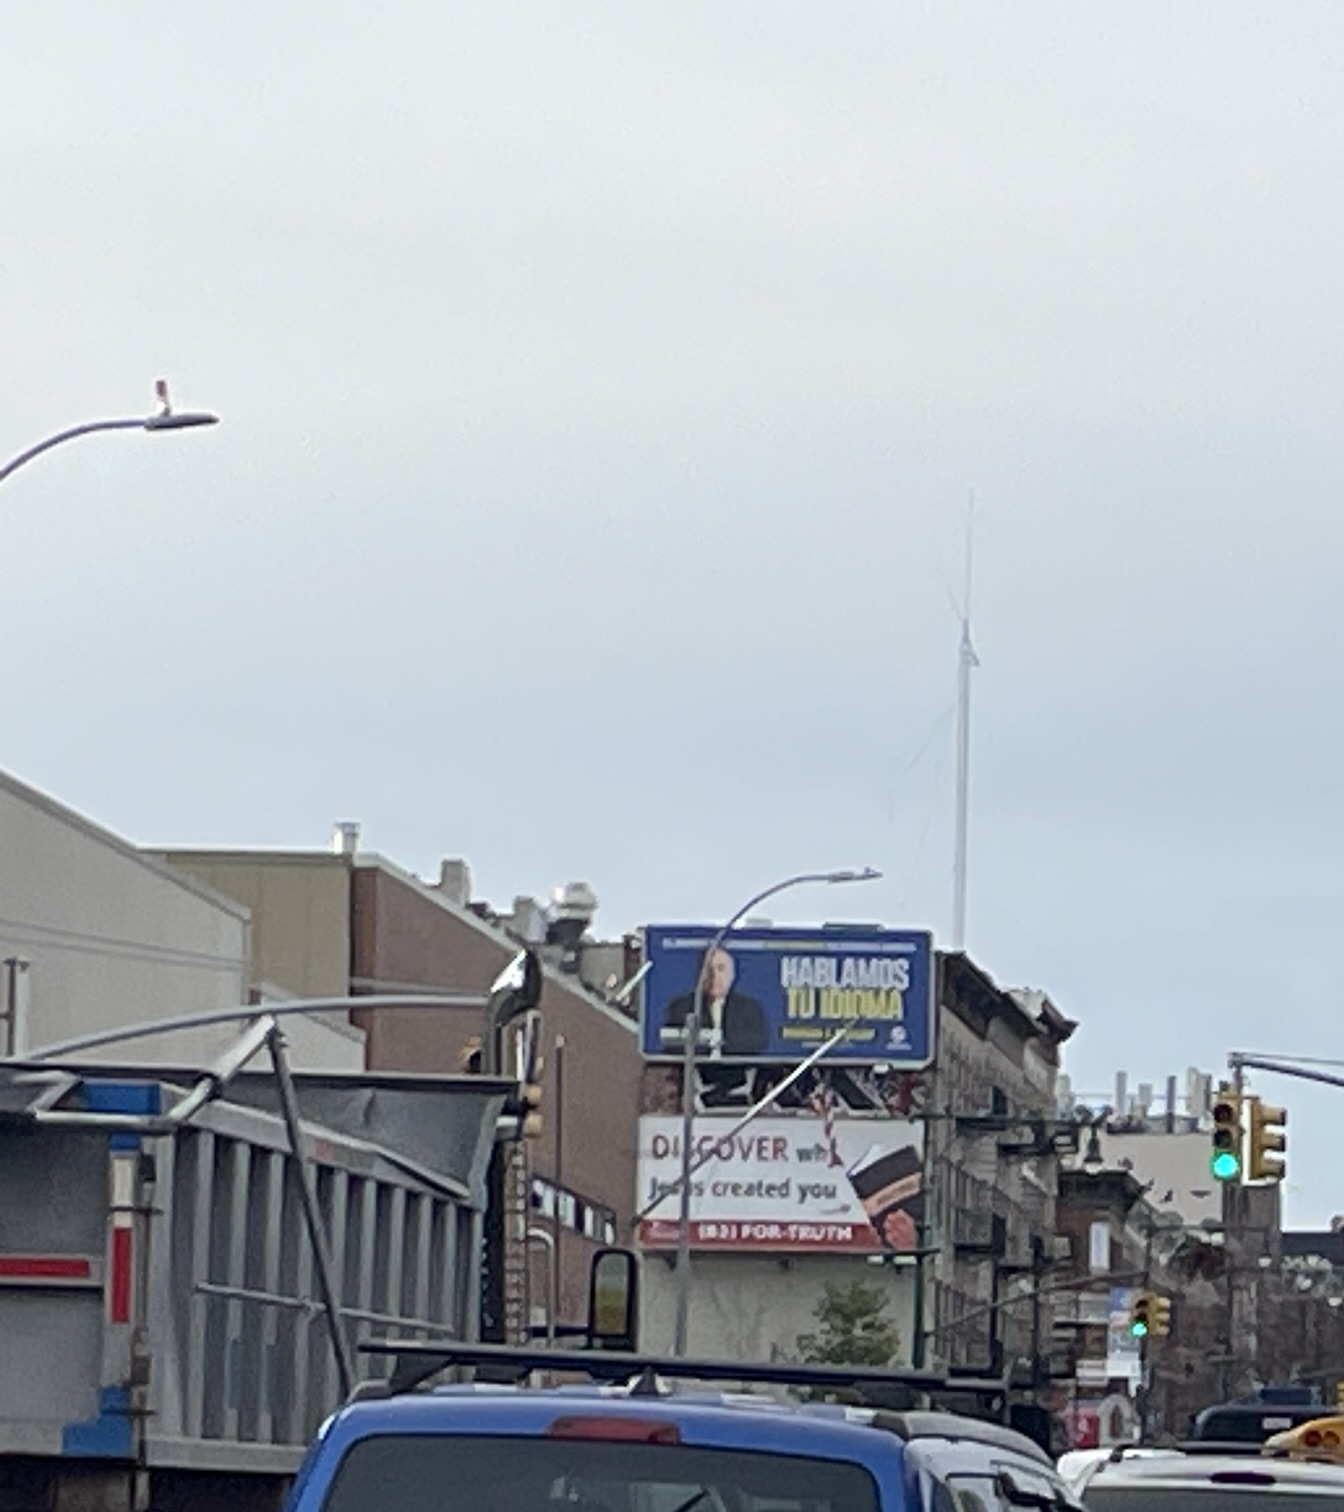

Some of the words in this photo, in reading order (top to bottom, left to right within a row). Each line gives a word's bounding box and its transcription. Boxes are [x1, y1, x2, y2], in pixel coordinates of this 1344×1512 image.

[781, 956, 909, 990] HABLAMOS
[819, 988, 903, 1019] IDIOMA
[712, 1177, 791, 1198] created
[796, 1186, 837, 1204] you
